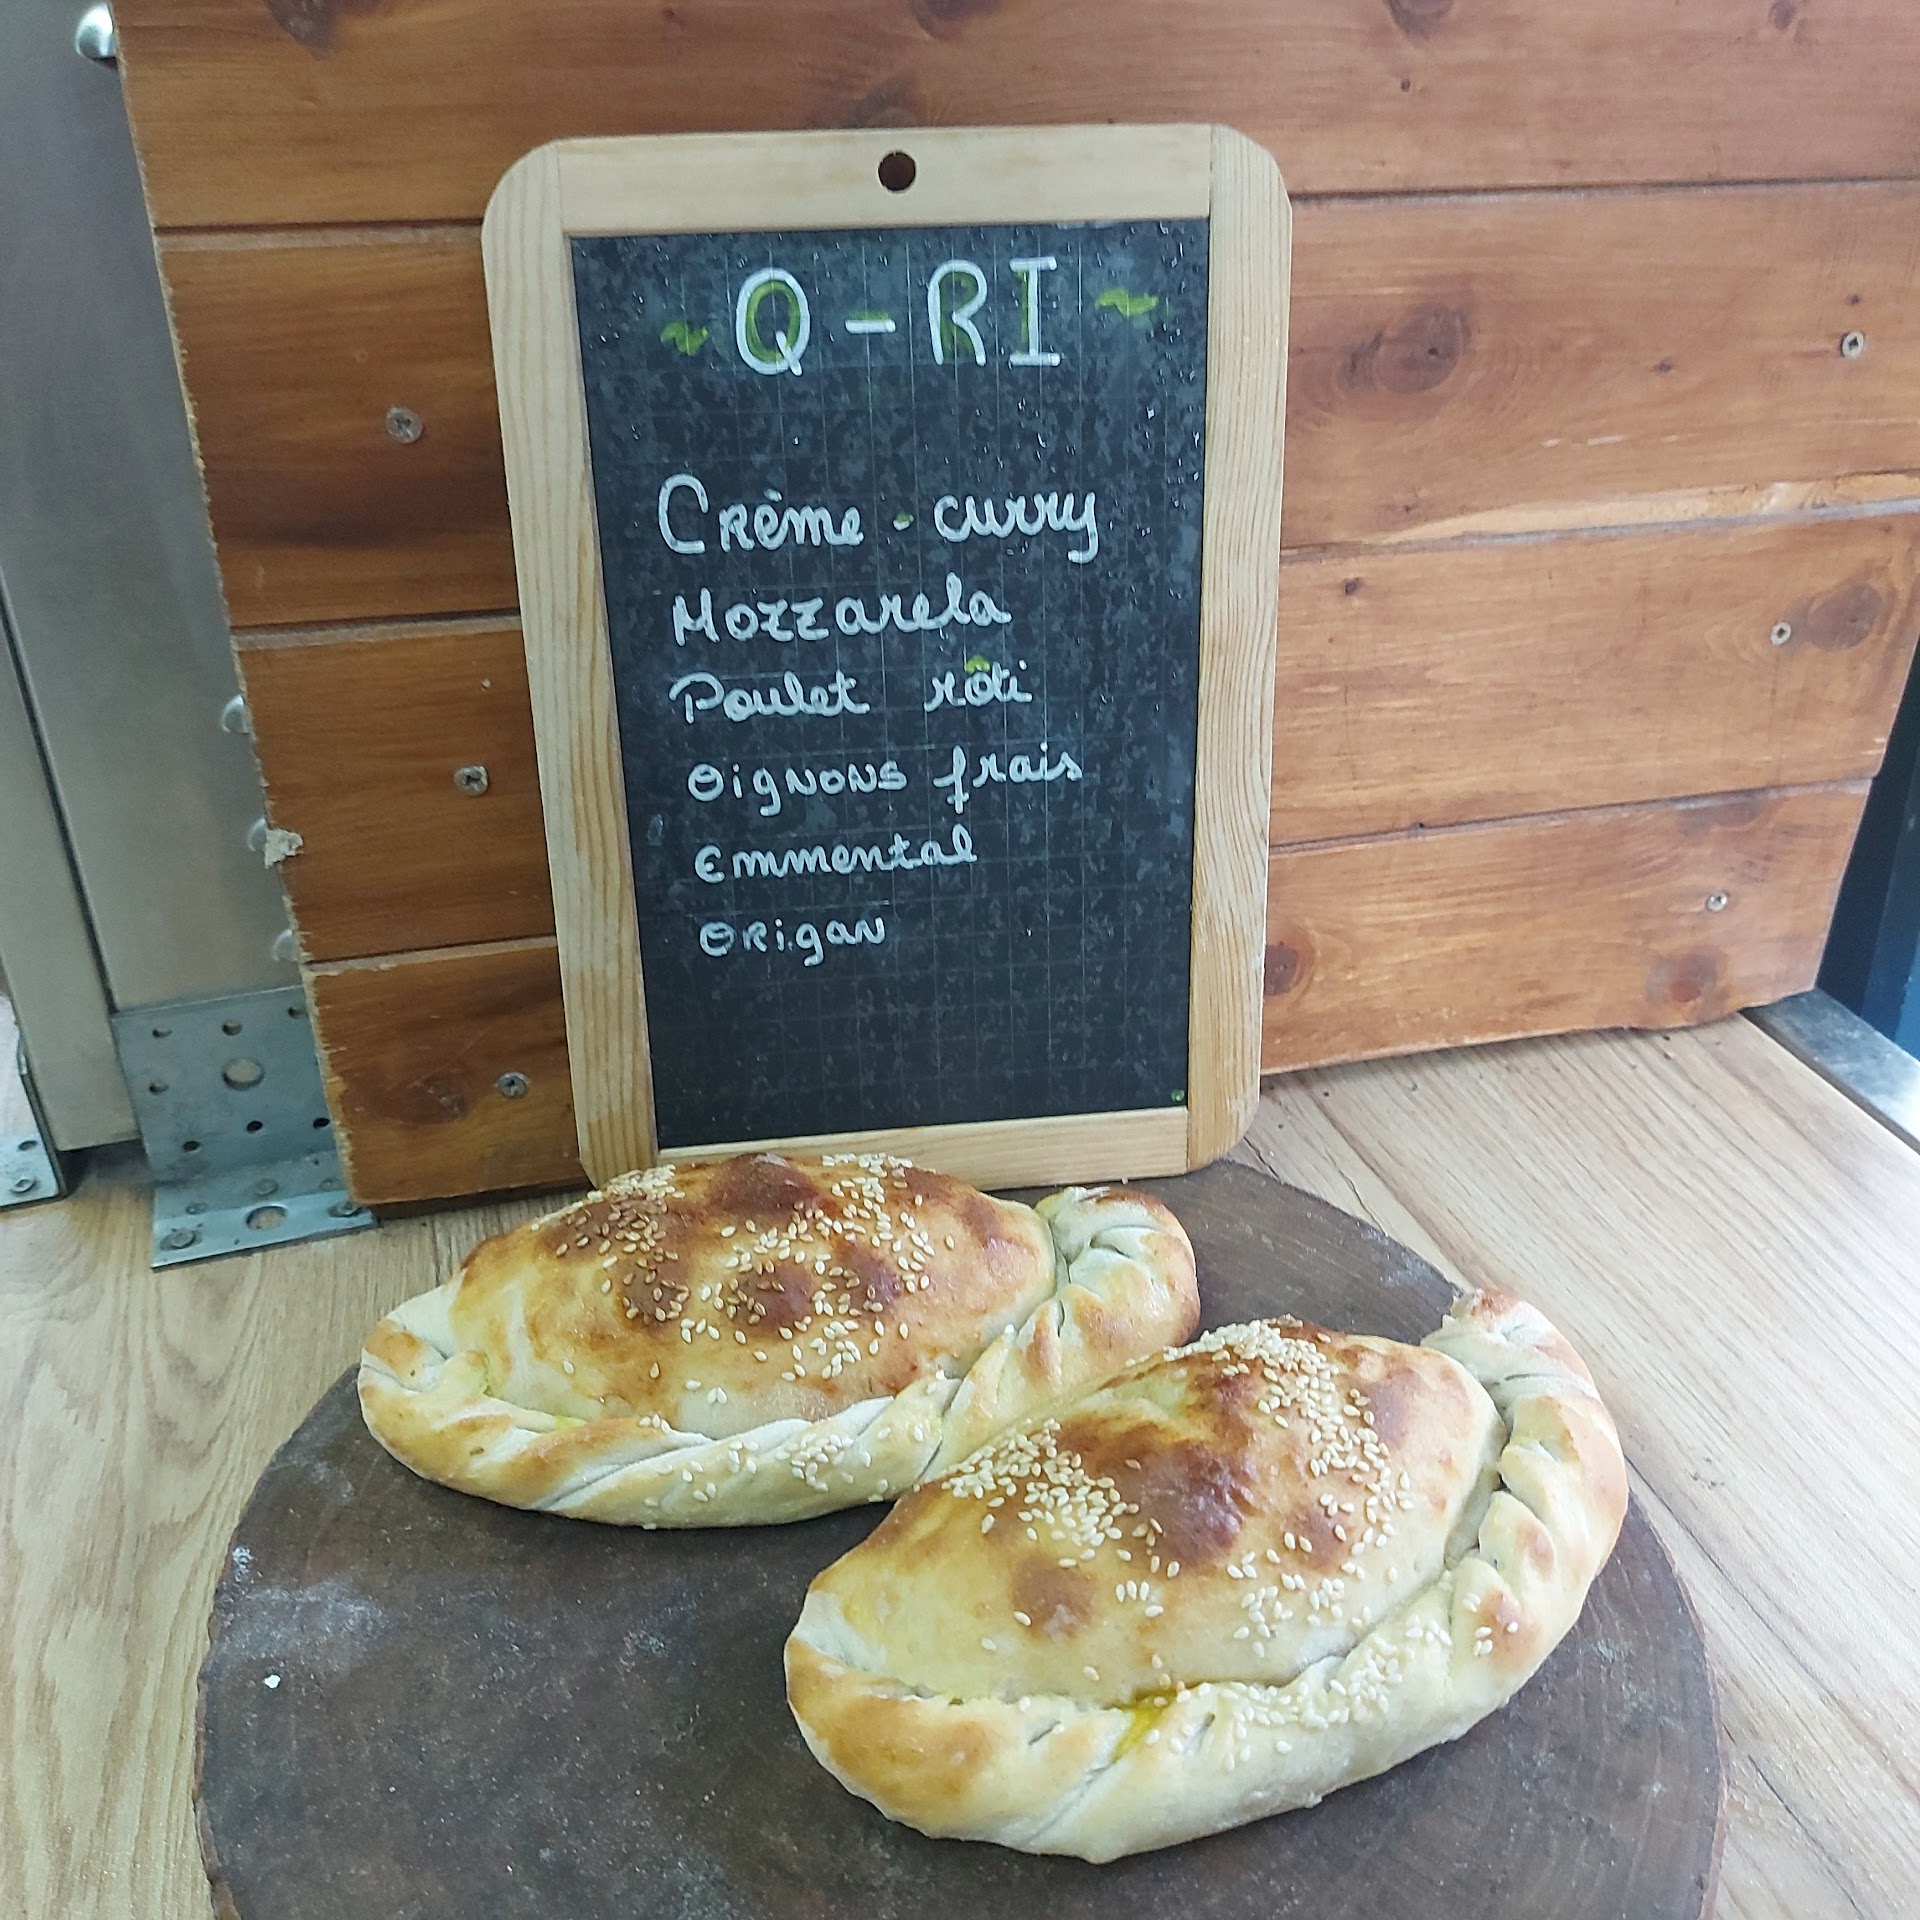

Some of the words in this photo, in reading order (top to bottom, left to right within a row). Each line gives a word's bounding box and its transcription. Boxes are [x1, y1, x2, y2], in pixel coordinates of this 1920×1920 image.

[668, 670, 871, 724] Poulet
[923, 655, 1033, 713] rôti
[933, 740, 1083, 814] frais
[694, 824, 978, 884] Emmental
